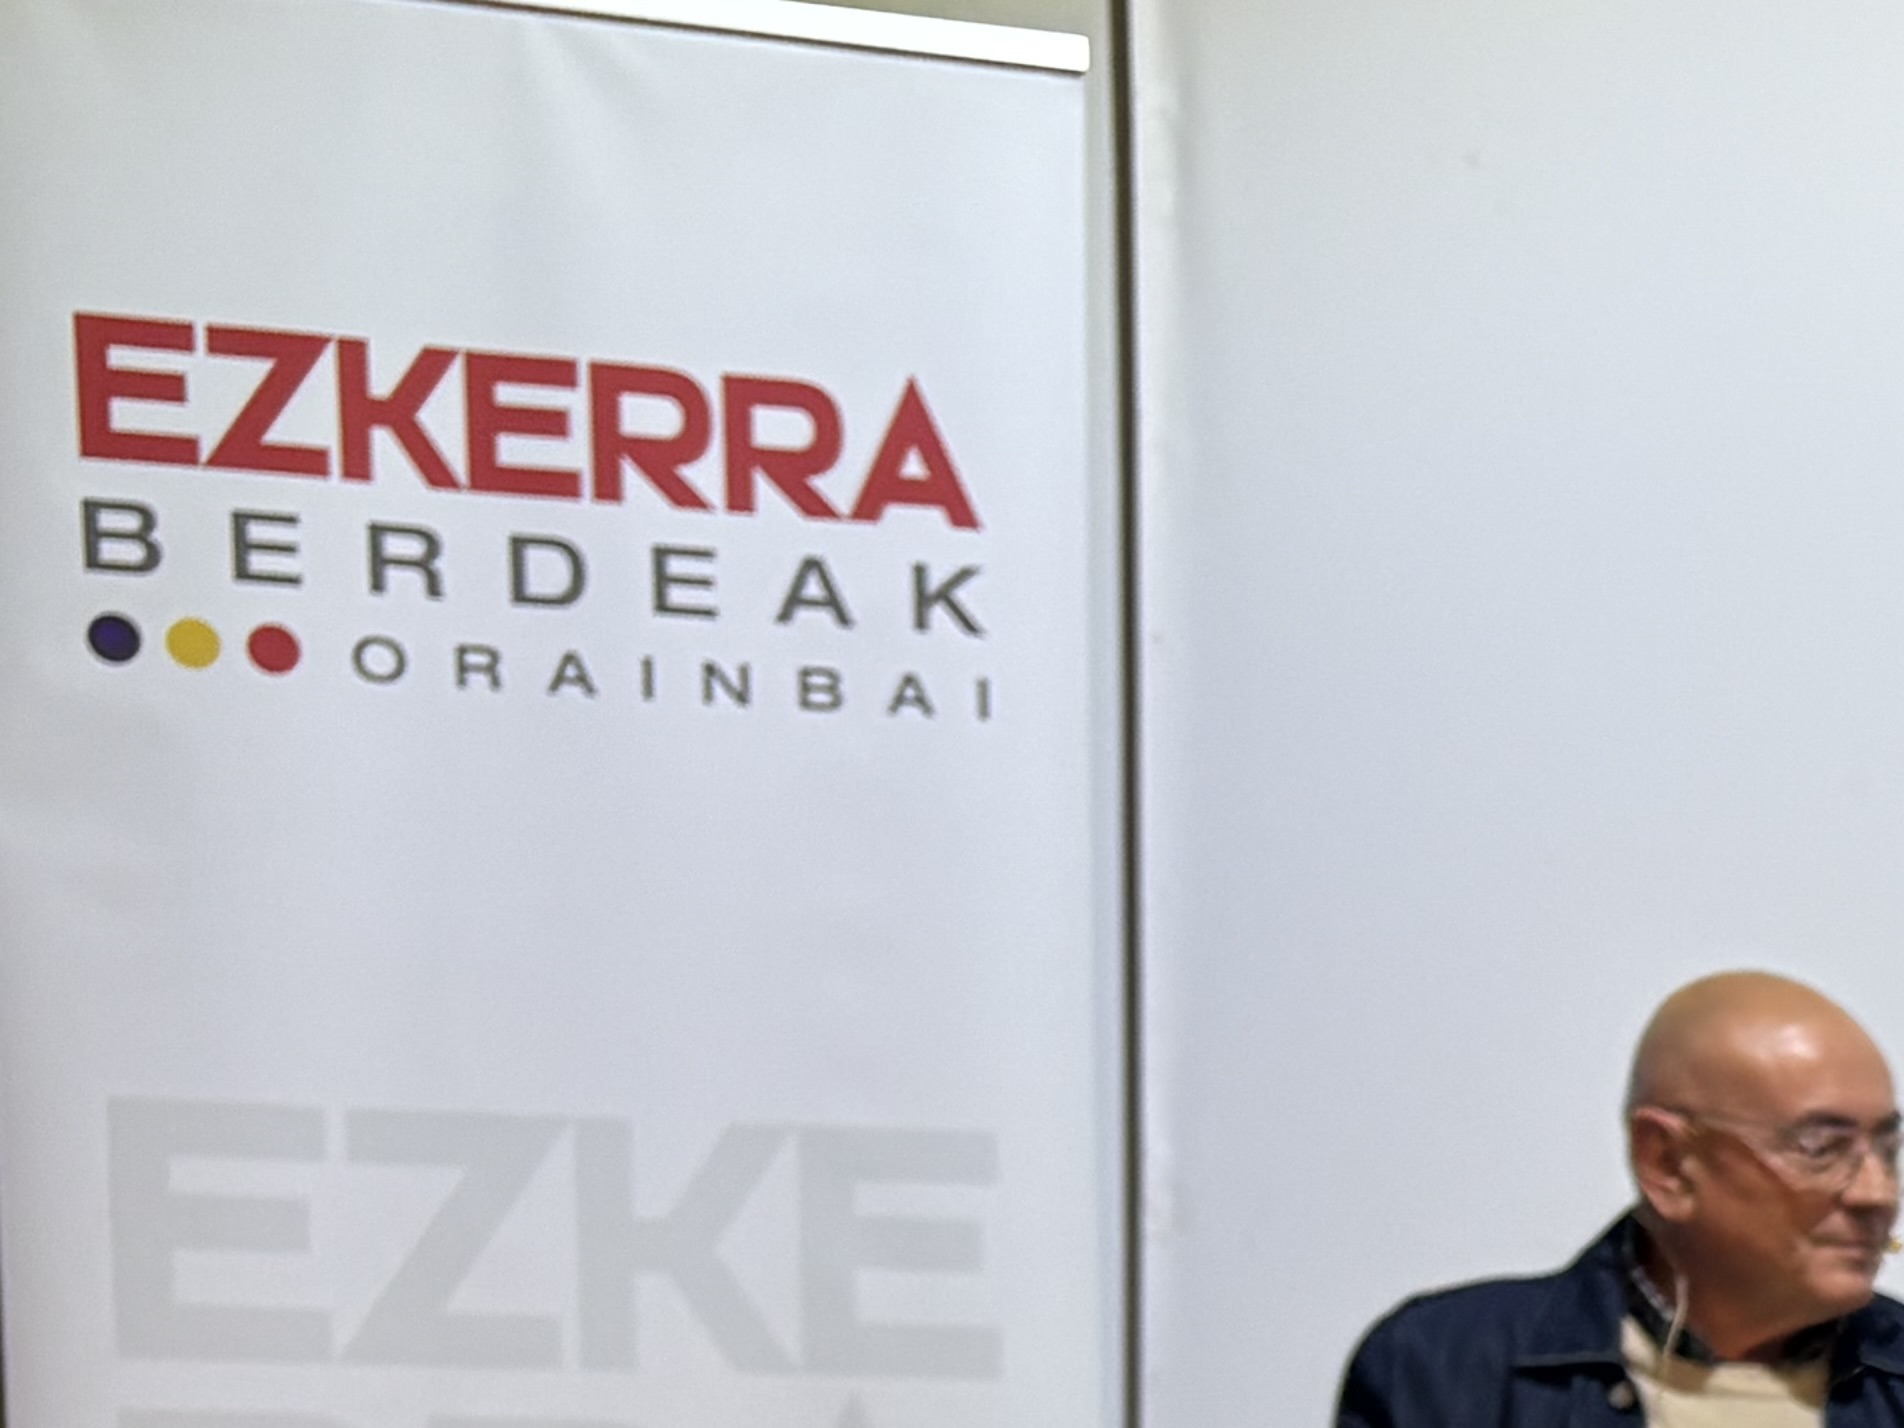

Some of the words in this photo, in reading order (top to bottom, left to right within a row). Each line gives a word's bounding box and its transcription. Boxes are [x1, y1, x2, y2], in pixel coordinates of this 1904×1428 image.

[73, 311, 982, 531] EZKERRA
[81, 498, 986, 637] BERDEAK
[351, 634, 991, 720] ORAINBAI
[107, 1096, 1001, 1378] EZKE
